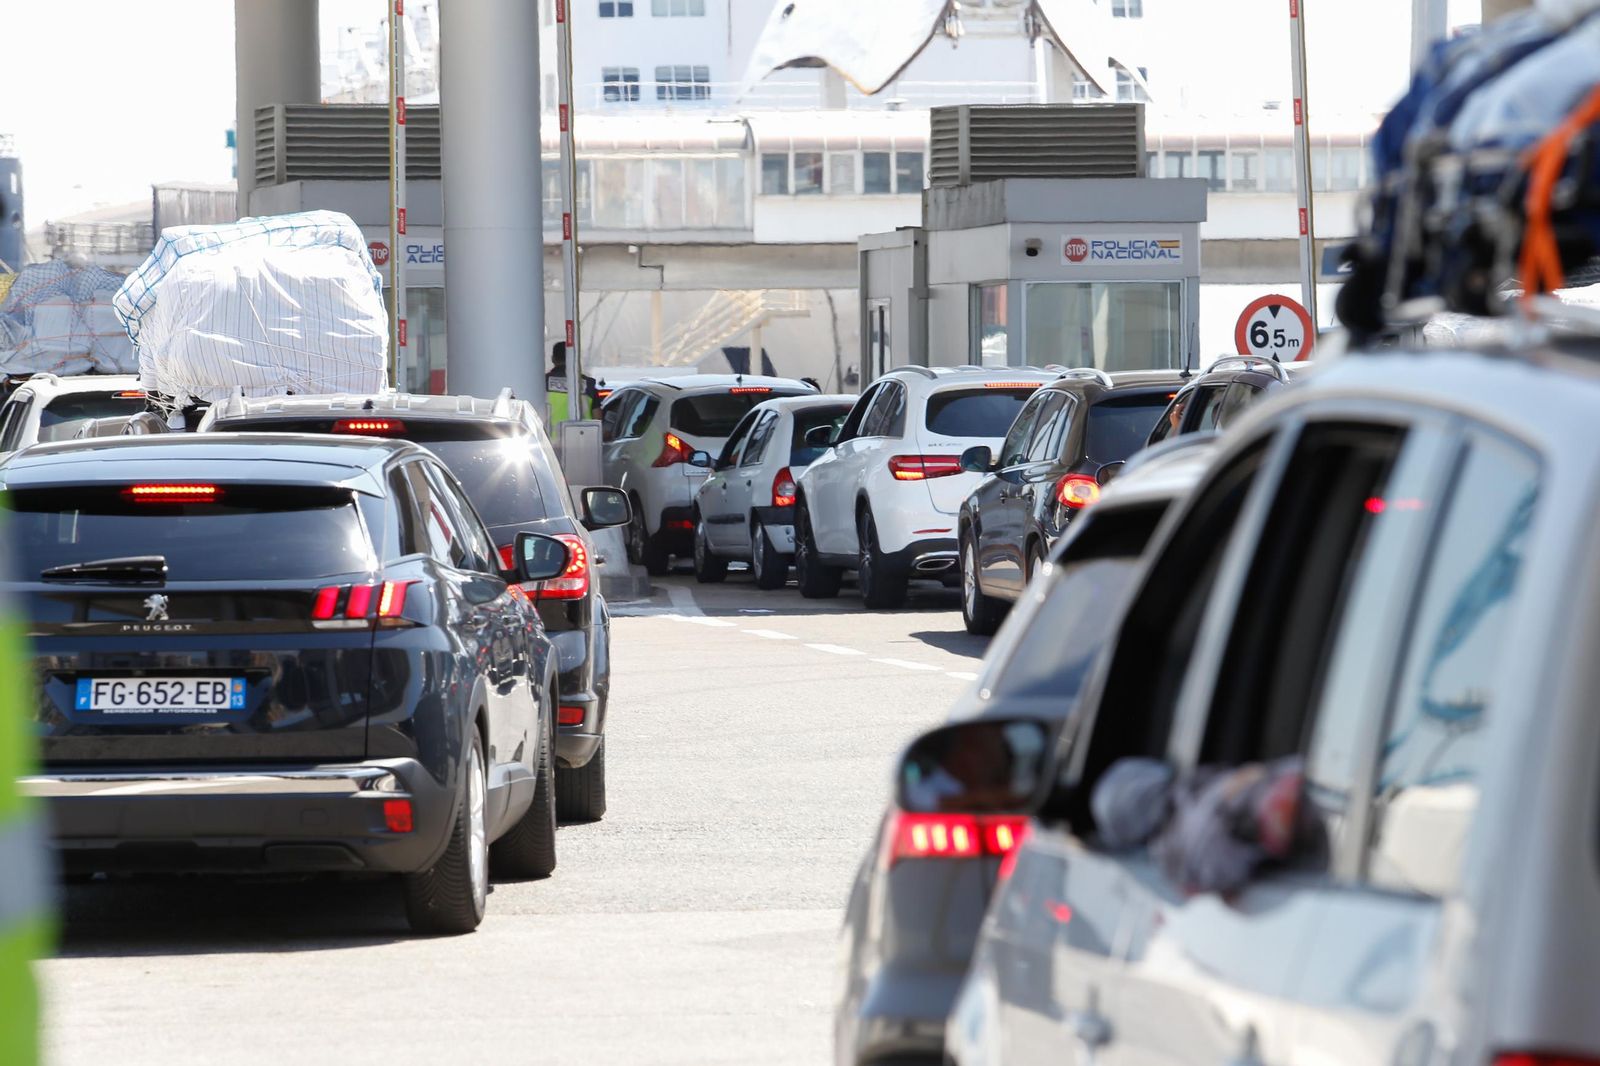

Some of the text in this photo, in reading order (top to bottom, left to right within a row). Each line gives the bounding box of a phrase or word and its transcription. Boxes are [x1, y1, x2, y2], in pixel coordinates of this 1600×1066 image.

[1066, 244, 1087, 256] STOP
[1091, 240, 1159, 250] POLICIA
[1091, 249, 1180, 260] NACIONAL
[122, 624, 193, 632] PEUGEOT
[93, 681, 228, 706] FG-652-EB
[231, 694, 244, 706] 13
